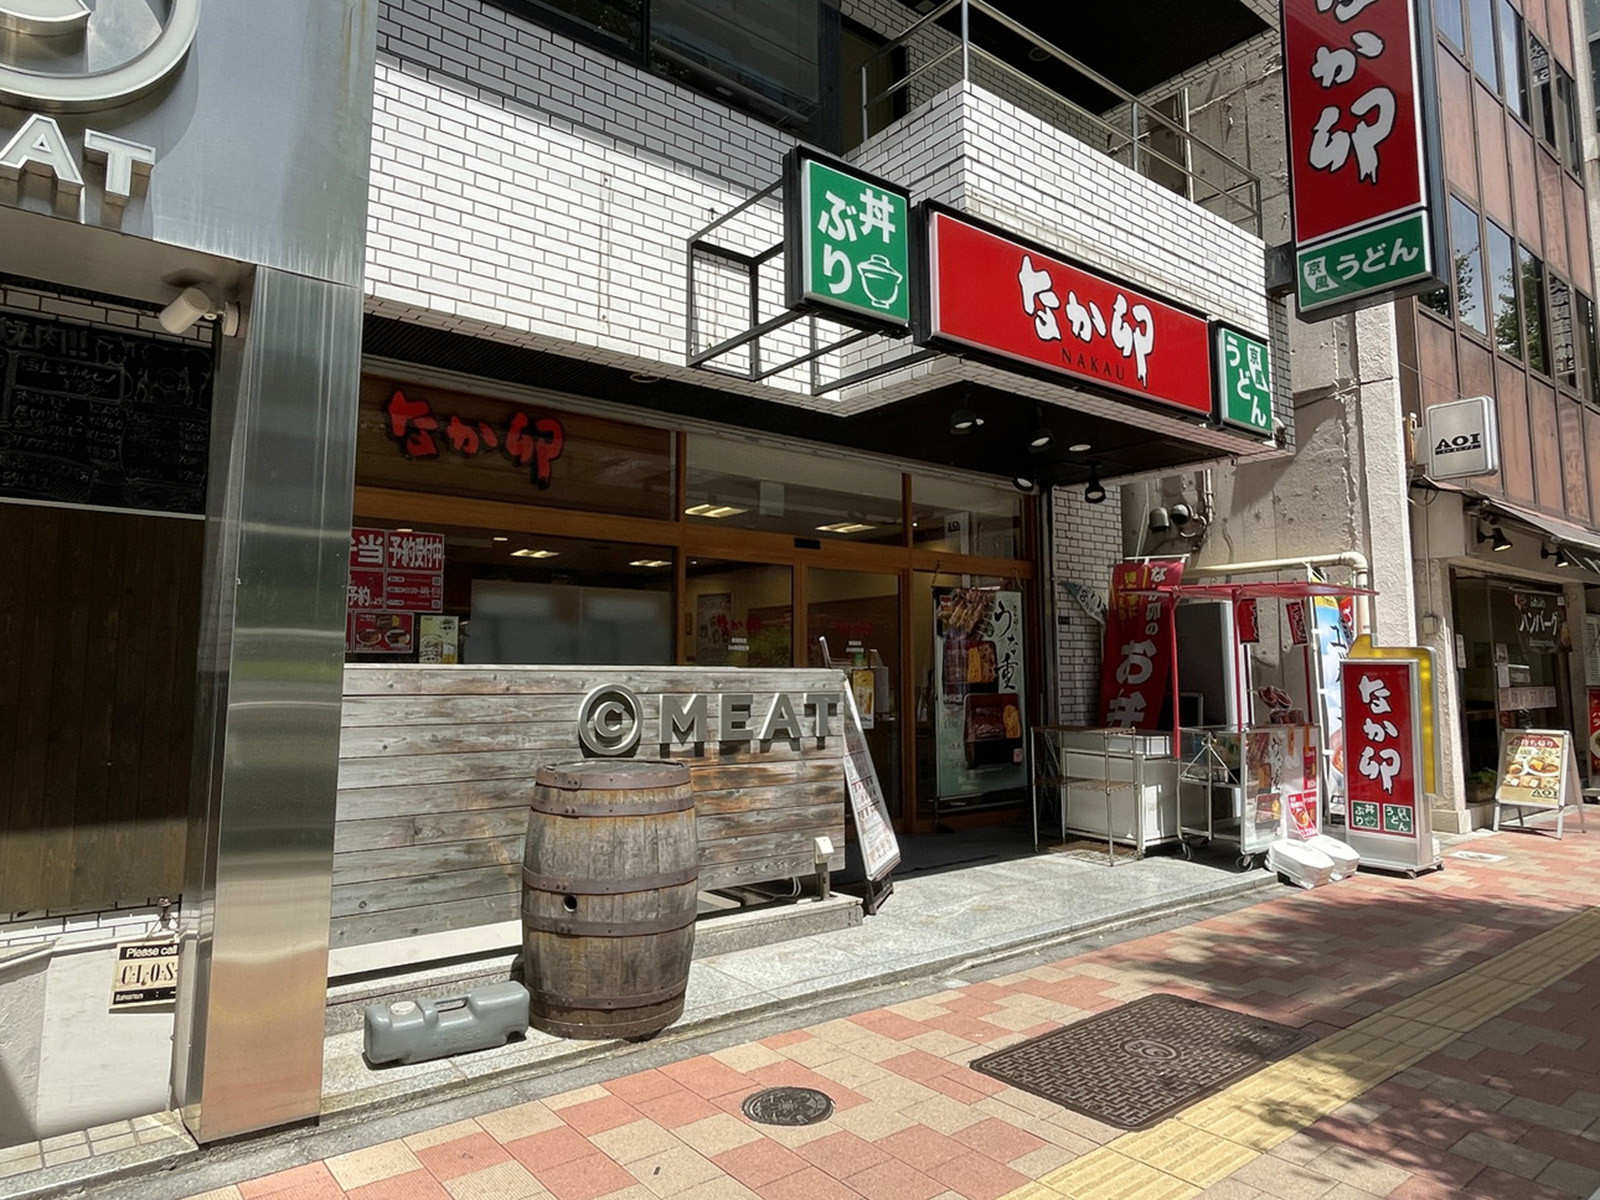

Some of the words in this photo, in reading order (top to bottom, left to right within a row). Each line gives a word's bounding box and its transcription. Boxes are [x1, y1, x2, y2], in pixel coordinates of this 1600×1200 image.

[1308, 0, 1396, 184] か卯
[1336, 238, 1419, 281] うどん
[1018, 255, 1154, 388] なか卯
[1060, 346, 1125, 380] NAKAU
[1226, 335, 1267, 428] うどん
[387, 391, 564, 486] なか卯
[1434, 433, 1480, 451] AOI
[1519, 610, 1558, 636] ハンバーグ
[658, 692, 840, 744] MEAT
[1358, 674, 1402, 795] なか卯
[126, 947, 159, 958] Please
